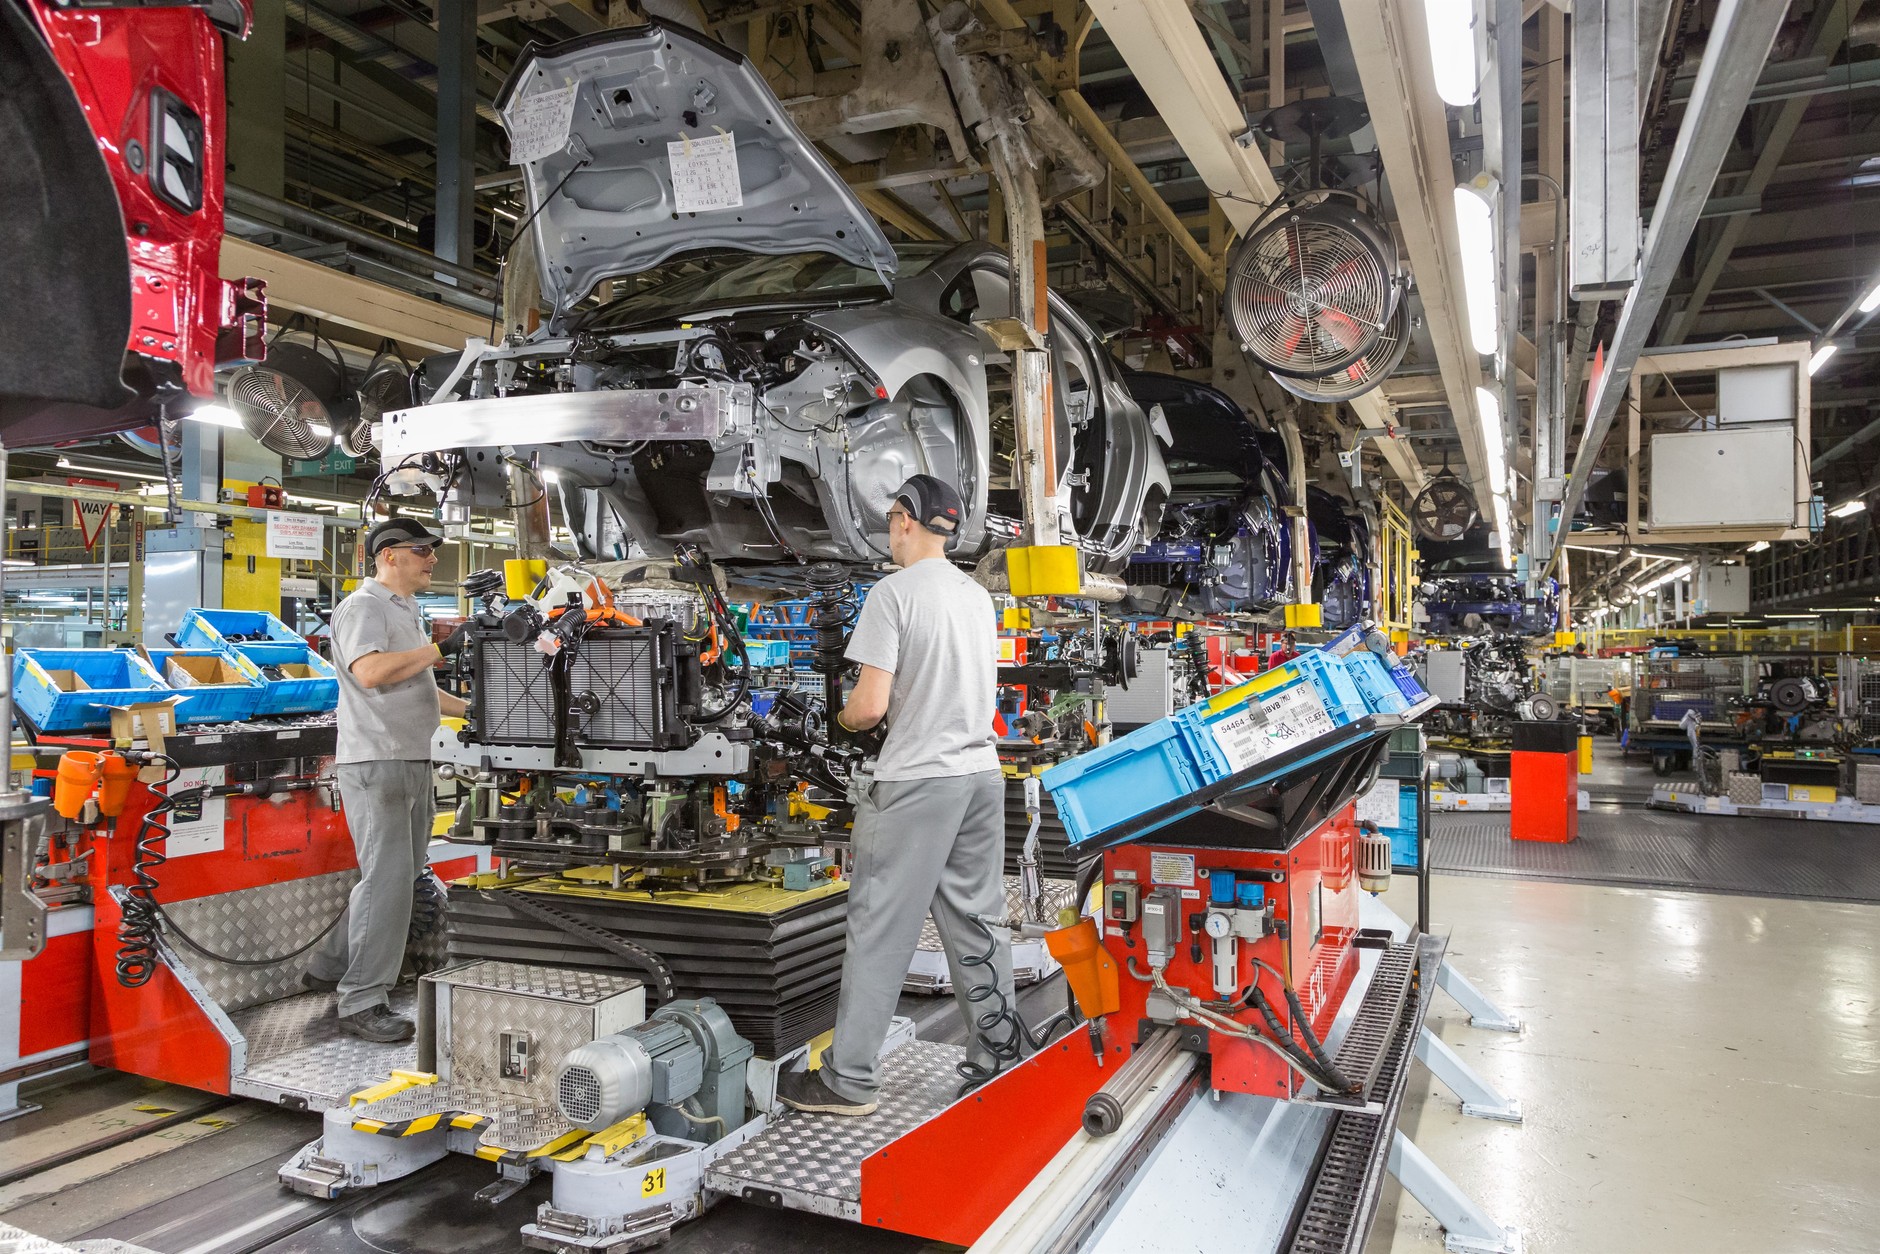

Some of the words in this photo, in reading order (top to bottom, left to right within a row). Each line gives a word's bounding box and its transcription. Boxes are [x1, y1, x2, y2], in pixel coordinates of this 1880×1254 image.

[334, 460, 352, 470] EXIT
[82, 502, 107, 515] WAY
[1296, 686, 1306, 695] FS
[645, 1172, 664, 1192] 31
